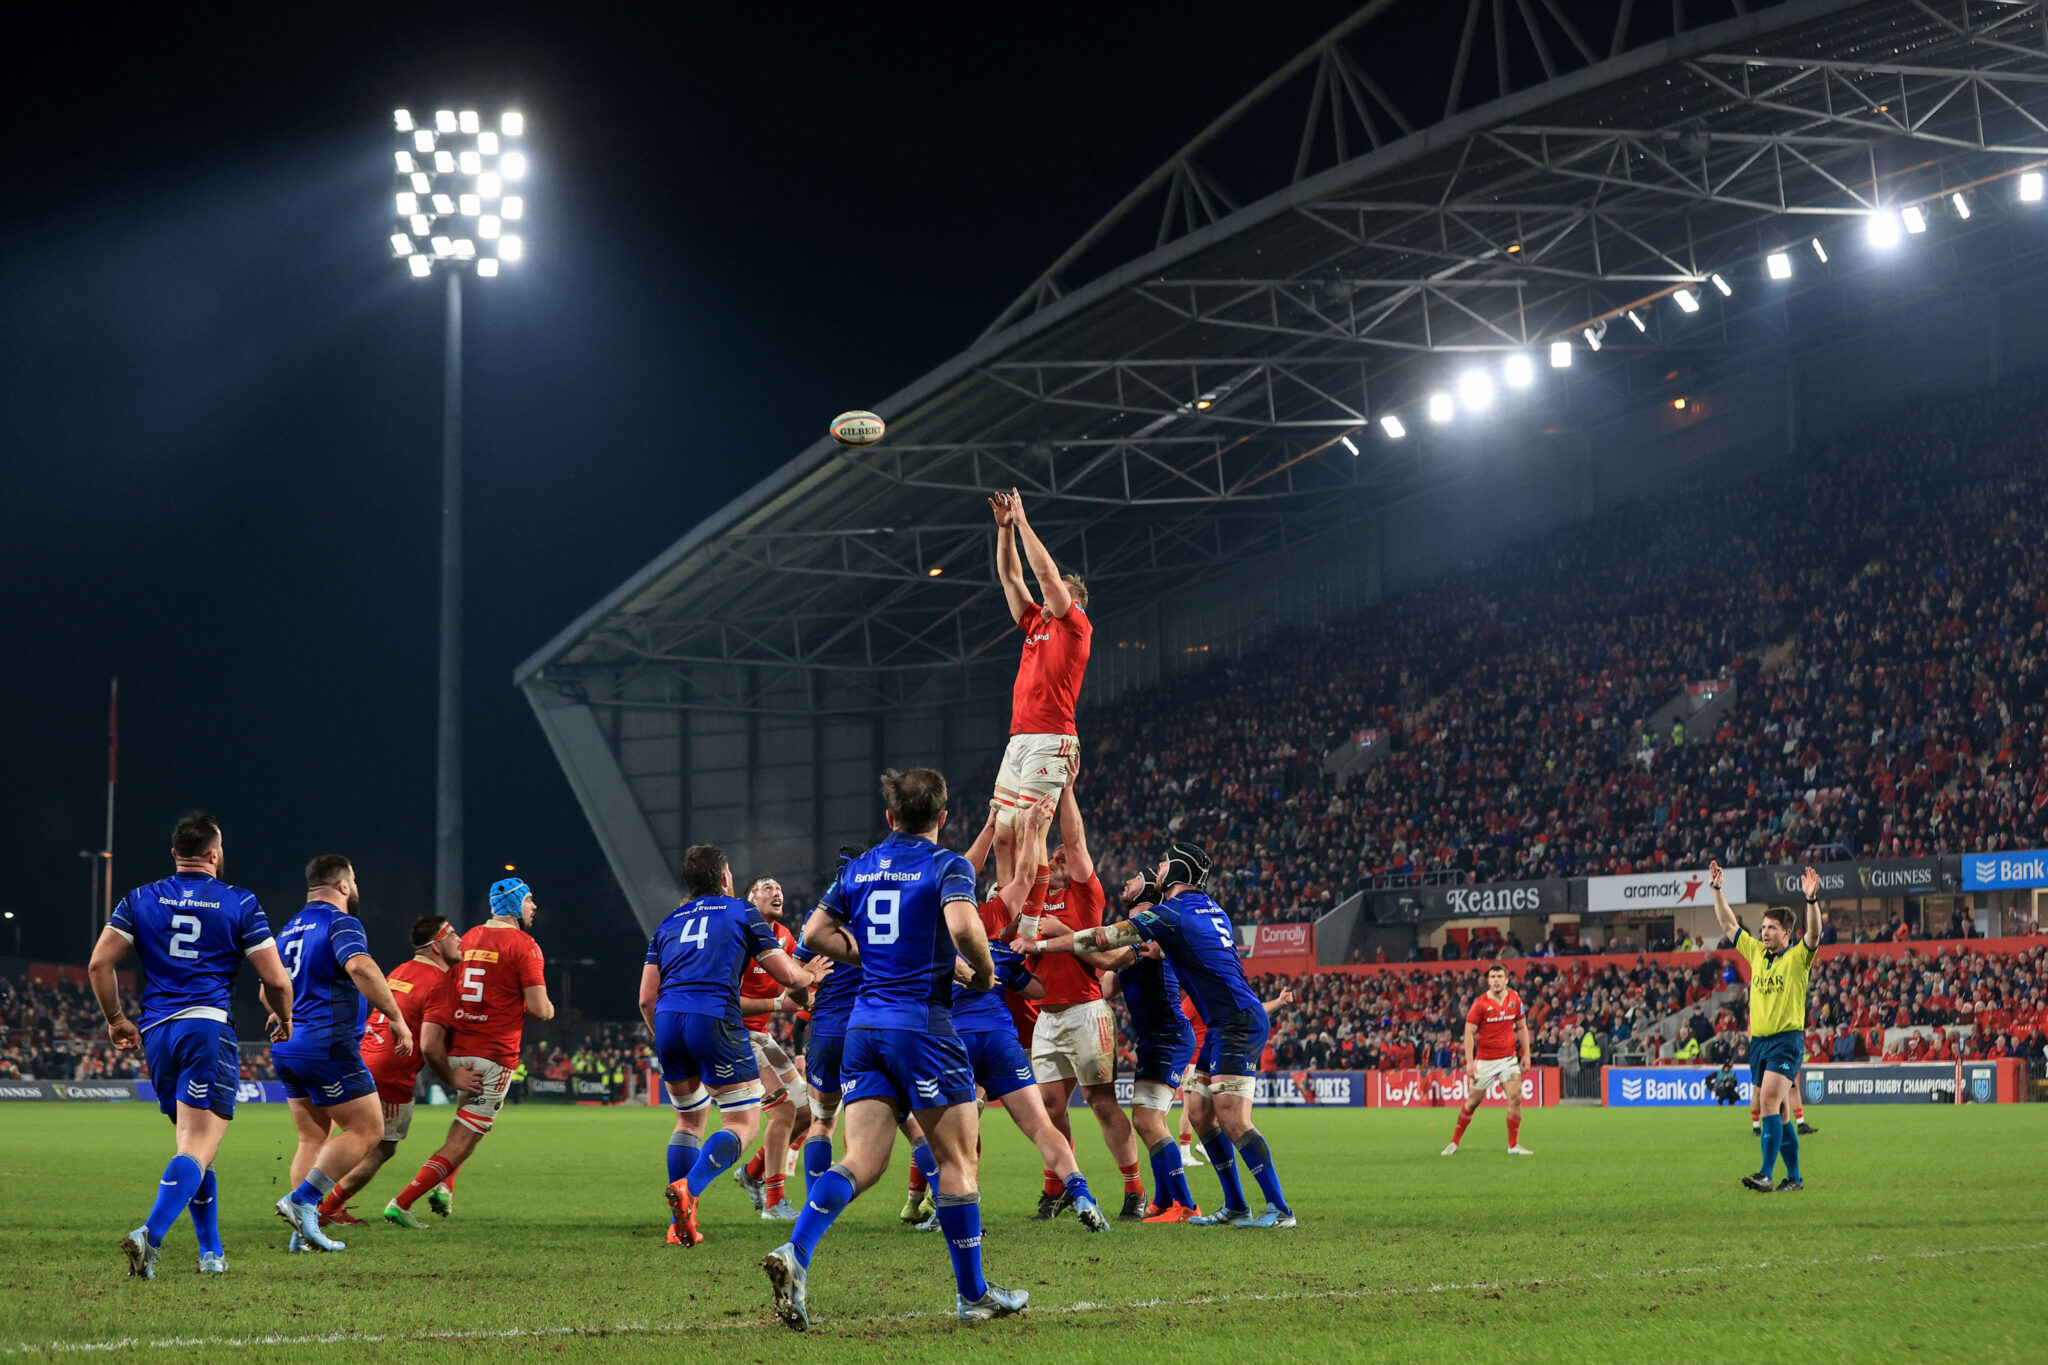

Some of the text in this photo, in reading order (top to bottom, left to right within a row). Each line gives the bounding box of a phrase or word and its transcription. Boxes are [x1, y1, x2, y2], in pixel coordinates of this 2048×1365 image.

[840, 426, 881, 437] GILBERT
[884, 871, 922, 881] Ireland
[1871, 868, 1932, 888] GUINNESS
[2000, 859, 2045, 881] Bank
[1624, 880, 1680, 899] aramark
[1786, 873, 1845, 893] GUNESS
[159, 896, 220, 909] Bank of Ireland
[1446, 887, 1540, 913] Keanes
[866, 889, 901, 945] 9
[169, 914, 202, 959] 2
[679, 915, 710, 950] 4
[1211, 917, 1235, 948] 5
[1262, 926, 1307, 945] Connolly
[284, 939, 304, 980] 3
[461, 967, 487, 1003] 5
[67, 1086, 130, 1098] GUINNESS
[1646, 1079, 1687, 1101] Bank
[1689, 1078, 1707, 1101] of
[1828, 1080, 1844, 1094] BKT
[1844, 1079, 1874, 1094] UNITED
[1875, 1079, 1902, 1094] RUGBY
[1903, 1078, 1966, 1094] CHAMPIONSHP
